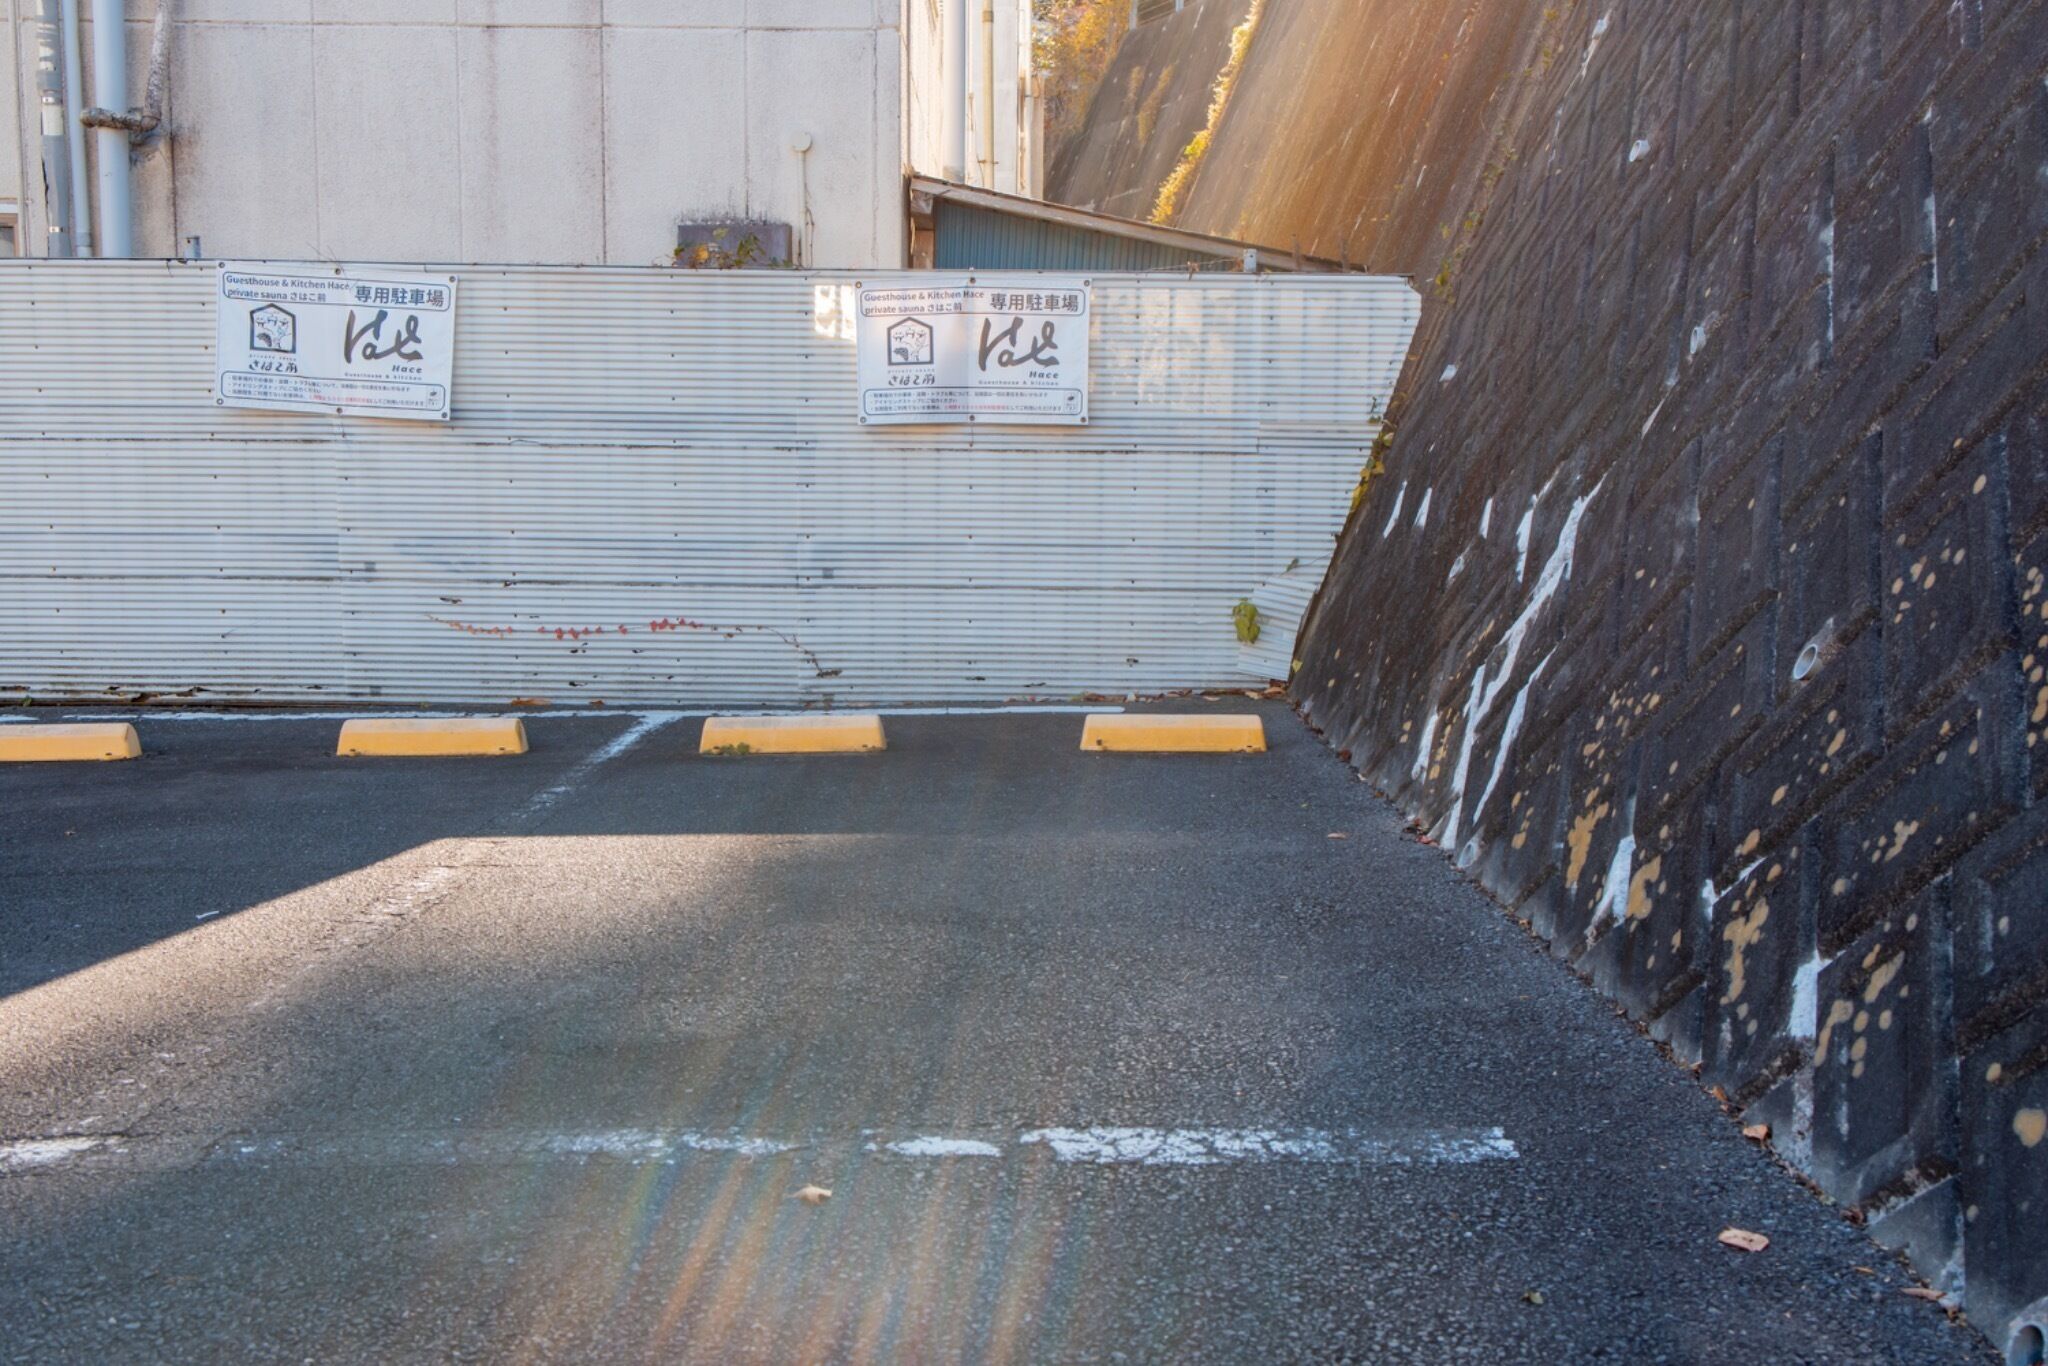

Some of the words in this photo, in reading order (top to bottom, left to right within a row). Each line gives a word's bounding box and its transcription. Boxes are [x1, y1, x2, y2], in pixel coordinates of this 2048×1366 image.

[226, 275, 280, 287] Guesthouse
[290, 280, 326, 289] Kitchen
[228, 288, 259, 298] private
[261, 291, 288, 300] sauna
[355, 285, 444, 307] 専用駐車場
[864, 292, 918, 302] Guesthouse
[927, 290, 961, 299] Kitchen
[963, 290, 985, 298] Hace
[990, 293, 1079, 312] 専用駐車場
[864, 305, 896, 315] private
[898, 304, 925, 312] sauna
[392, 365, 423, 374] Hace
[1029, 371, 1059, 379] Hace
